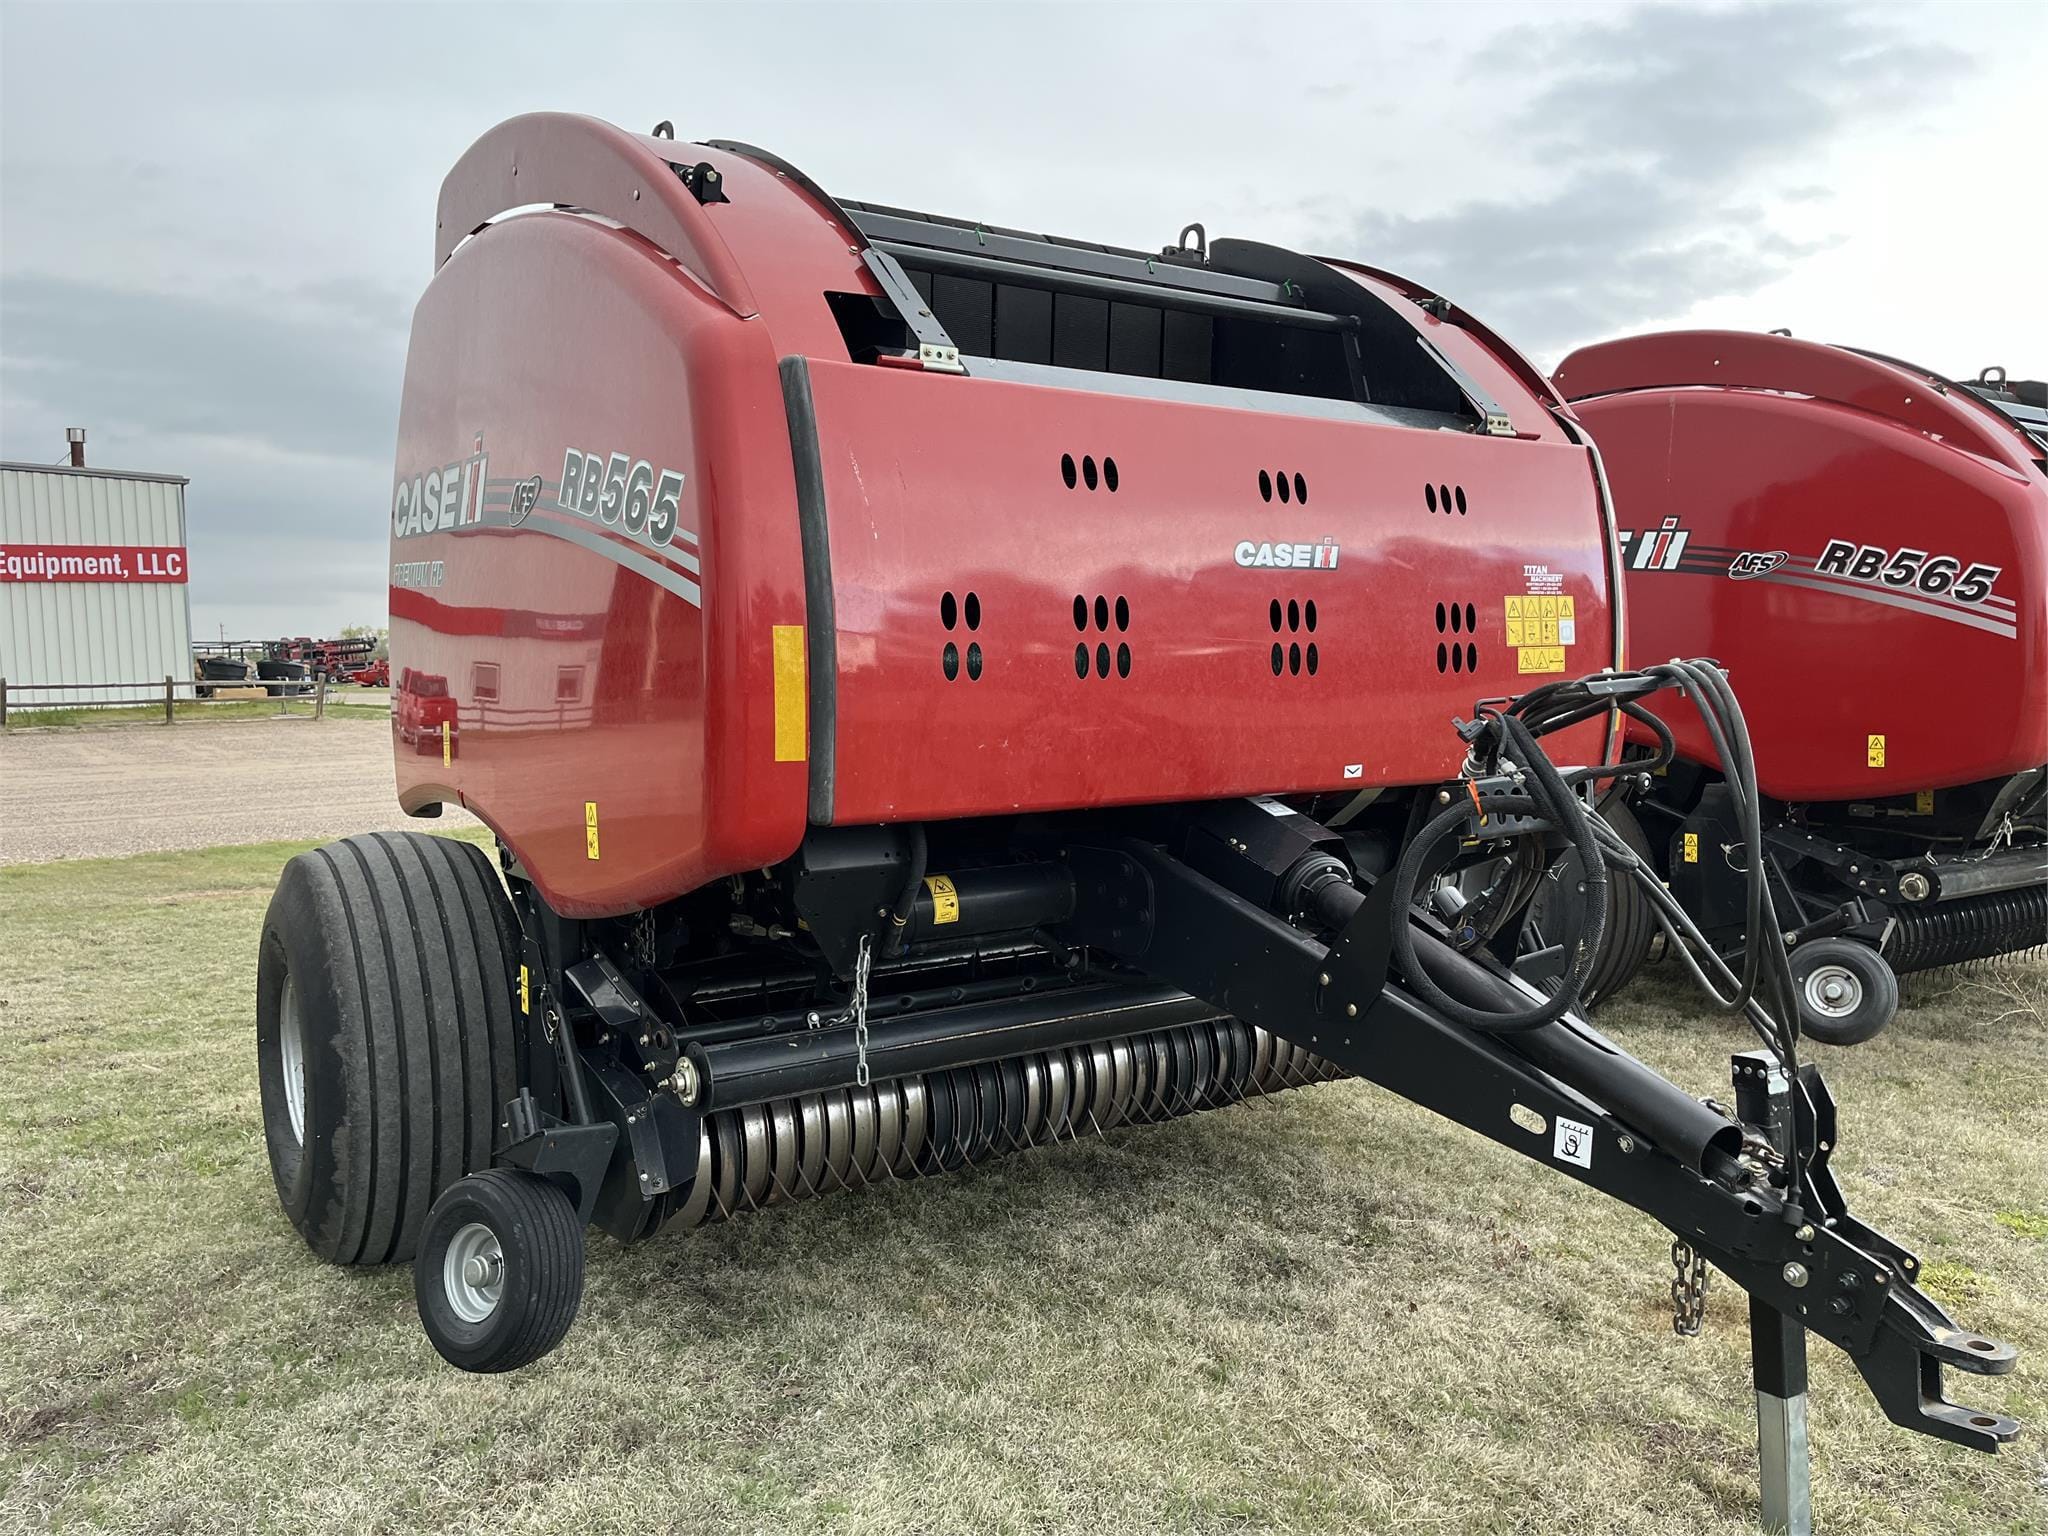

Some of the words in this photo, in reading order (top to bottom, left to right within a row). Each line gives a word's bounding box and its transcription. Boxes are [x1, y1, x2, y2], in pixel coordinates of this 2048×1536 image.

[394, 466, 460, 538] CASE
[558, 447, 685, 547] RB565
[0, 551, 129, 580] Equipment,
[137, 553, 182, 576] LLC
[1234, 541, 1312, 568] CASE
[1728, 552, 1777, 573] AFS
[1523, 565, 1548, 574] TITAN
[1814, 538, 2002, 604] RB565
